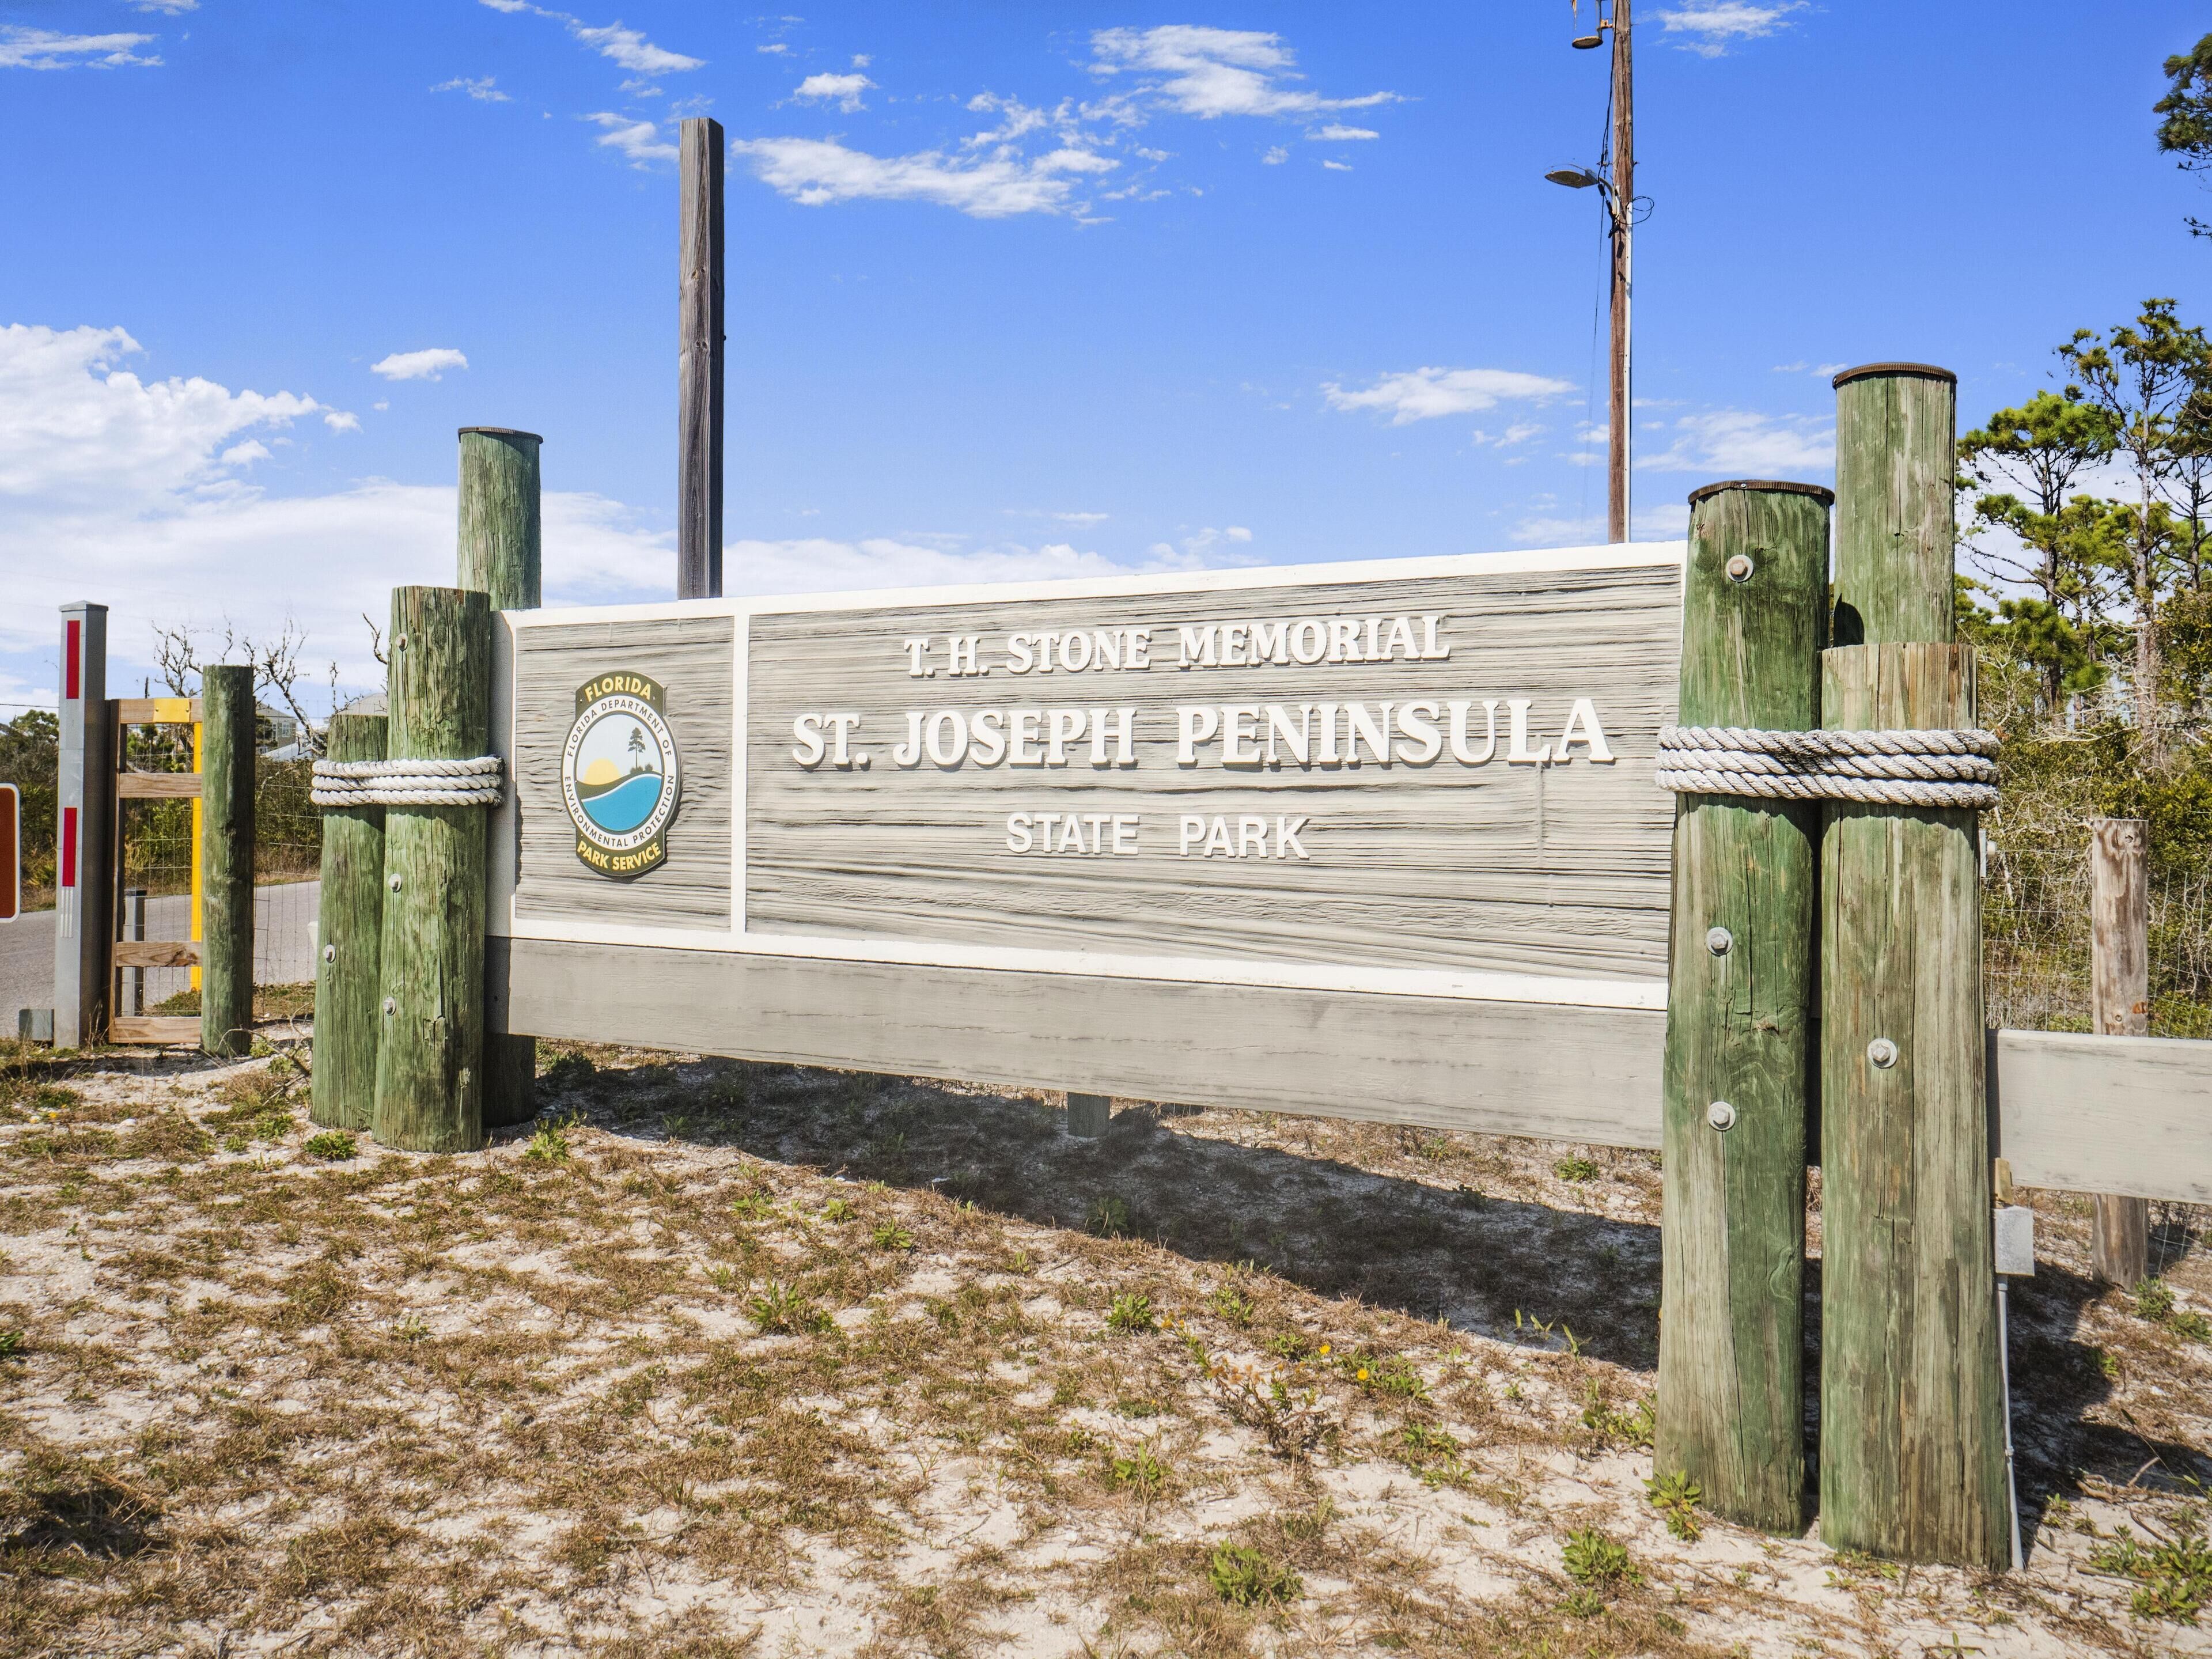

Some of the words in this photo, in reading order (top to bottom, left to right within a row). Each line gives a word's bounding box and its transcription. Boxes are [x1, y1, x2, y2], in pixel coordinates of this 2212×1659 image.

[904, 637, 934, 677] T.
[947, 637, 989, 676] H.
[1006, 628, 1151, 675] STONE
[1178, 615, 1450, 669] MEMORIAL
[585, 676, 652, 703] FLORIDA
[567, 709, 597, 757] FLORIDA
[601, 699, 663, 734] DEPARTMENT
[662, 740, 672, 756] OF
[792, 712, 871, 769] ST.
[893, 706, 1138, 770] JOSEPH
[1176, 698, 1614, 769] PENINSULA
[565, 776, 628, 847] ENVIRONMENTAL
[633, 775, 674, 842] PROTECTION
[1006, 813, 1140, 856] STATE
[1179, 815, 1310, 859] PARK
[577, 840, 609, 869] PARK
[612, 842, 662, 871] SERVICE
